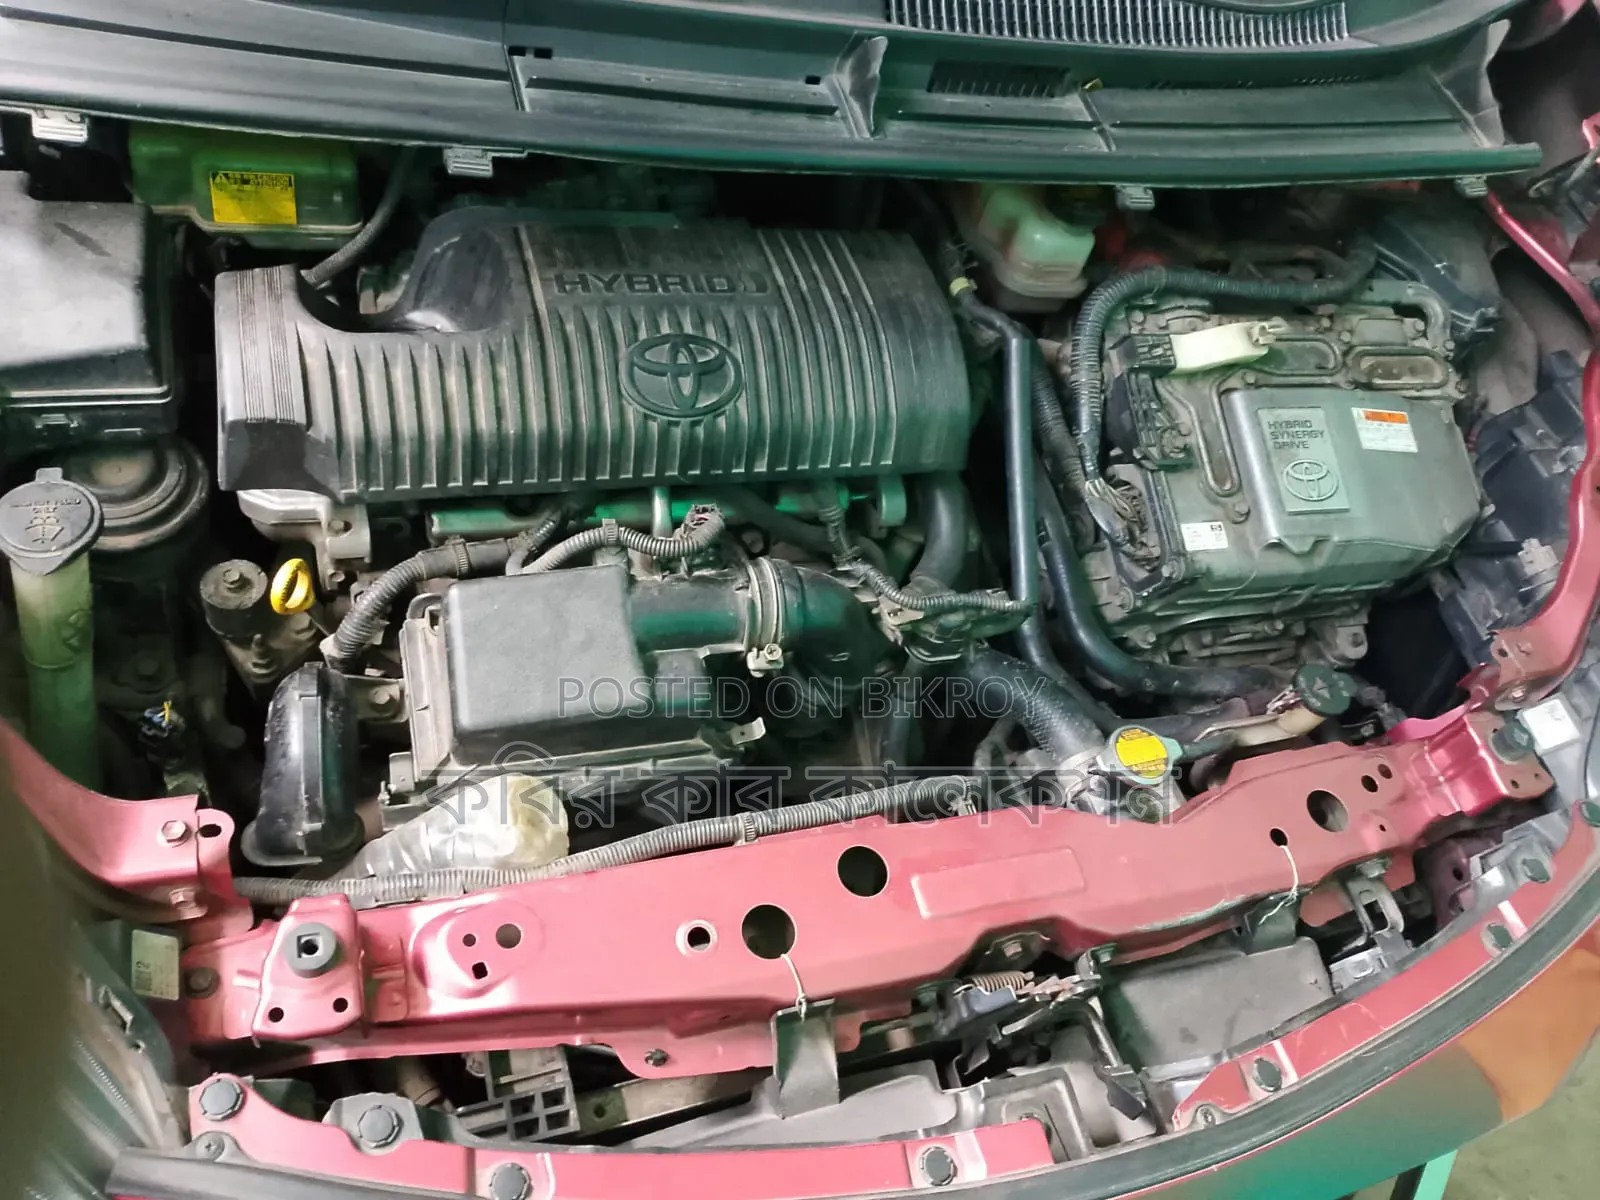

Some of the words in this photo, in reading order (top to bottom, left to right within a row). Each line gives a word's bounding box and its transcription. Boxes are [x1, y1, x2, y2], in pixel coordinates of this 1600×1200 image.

[554, 273, 736, 294] HYBRID
[1267, 420, 1313, 430] HYBRID
[1270, 430, 1325, 440] SYNERGY
[1273, 441, 1310, 449] DRIVE
